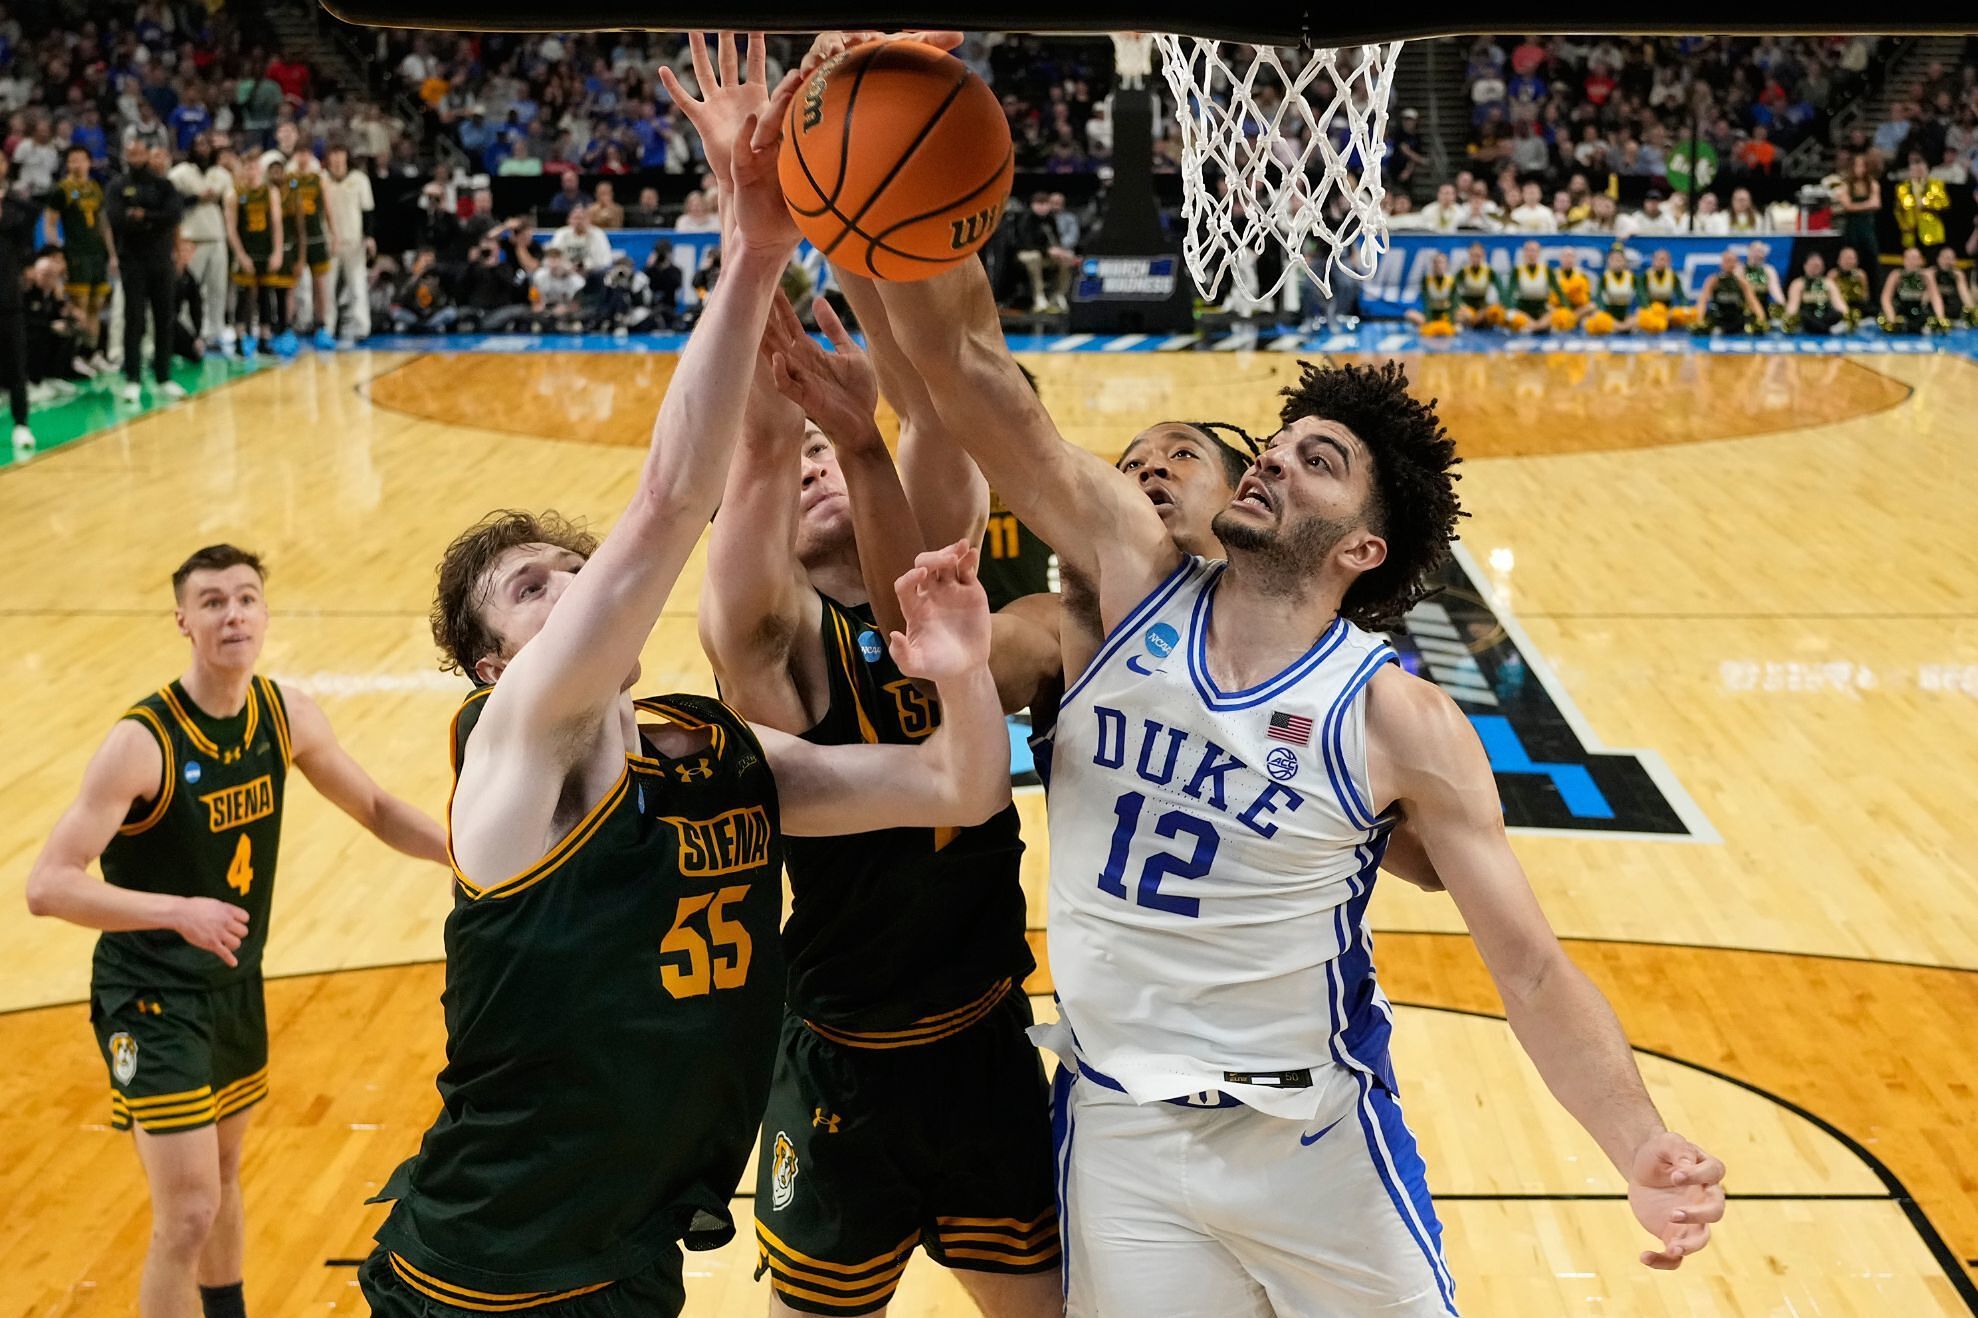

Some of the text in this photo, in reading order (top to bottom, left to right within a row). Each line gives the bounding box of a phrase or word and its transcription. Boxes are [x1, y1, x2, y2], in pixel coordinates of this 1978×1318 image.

[988, 515, 1019, 559] 11
[1093, 705, 1305, 840] DUKE
[1270, 757, 1297, 770] ACC
[213, 781, 271, 827] SIENA
[226, 832, 254, 896] 4
[681, 811, 768, 871] SIENA
[1097, 791, 1221, 918] 12
[660, 884, 752, 1000] 55
